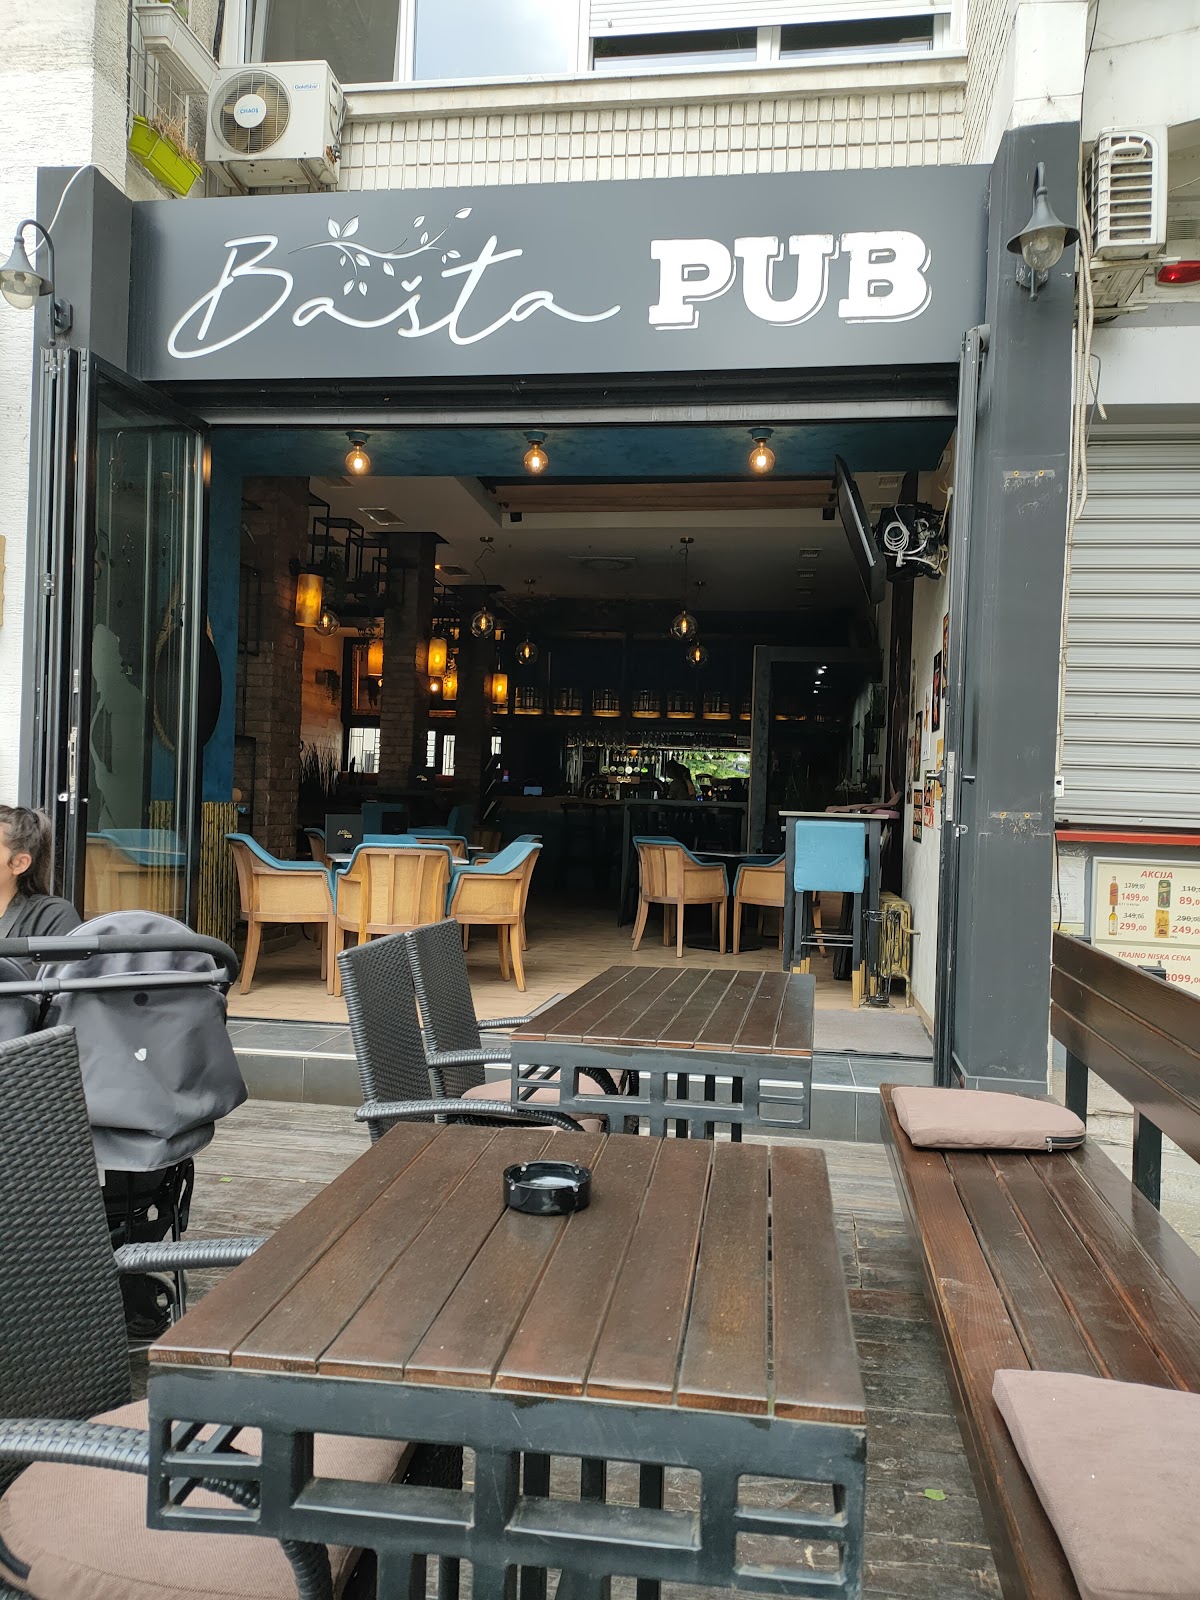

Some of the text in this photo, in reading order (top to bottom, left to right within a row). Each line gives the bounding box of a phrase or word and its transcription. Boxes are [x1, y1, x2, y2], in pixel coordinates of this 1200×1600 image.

[167, 230, 933, 359] Bašta PUB
[1140, 870, 1174, 879] AKCIJA
[1121, 892, 1150, 902] 1499,00
[1179, 896, 1200, 906] 89,0
[1119, 922, 1148, 932] 299,00
[1172, 925, 1200, 935] 249,0
[1117, 951, 1146, 959] TRAJNO
[1171, 954, 1192, 962] CENA
